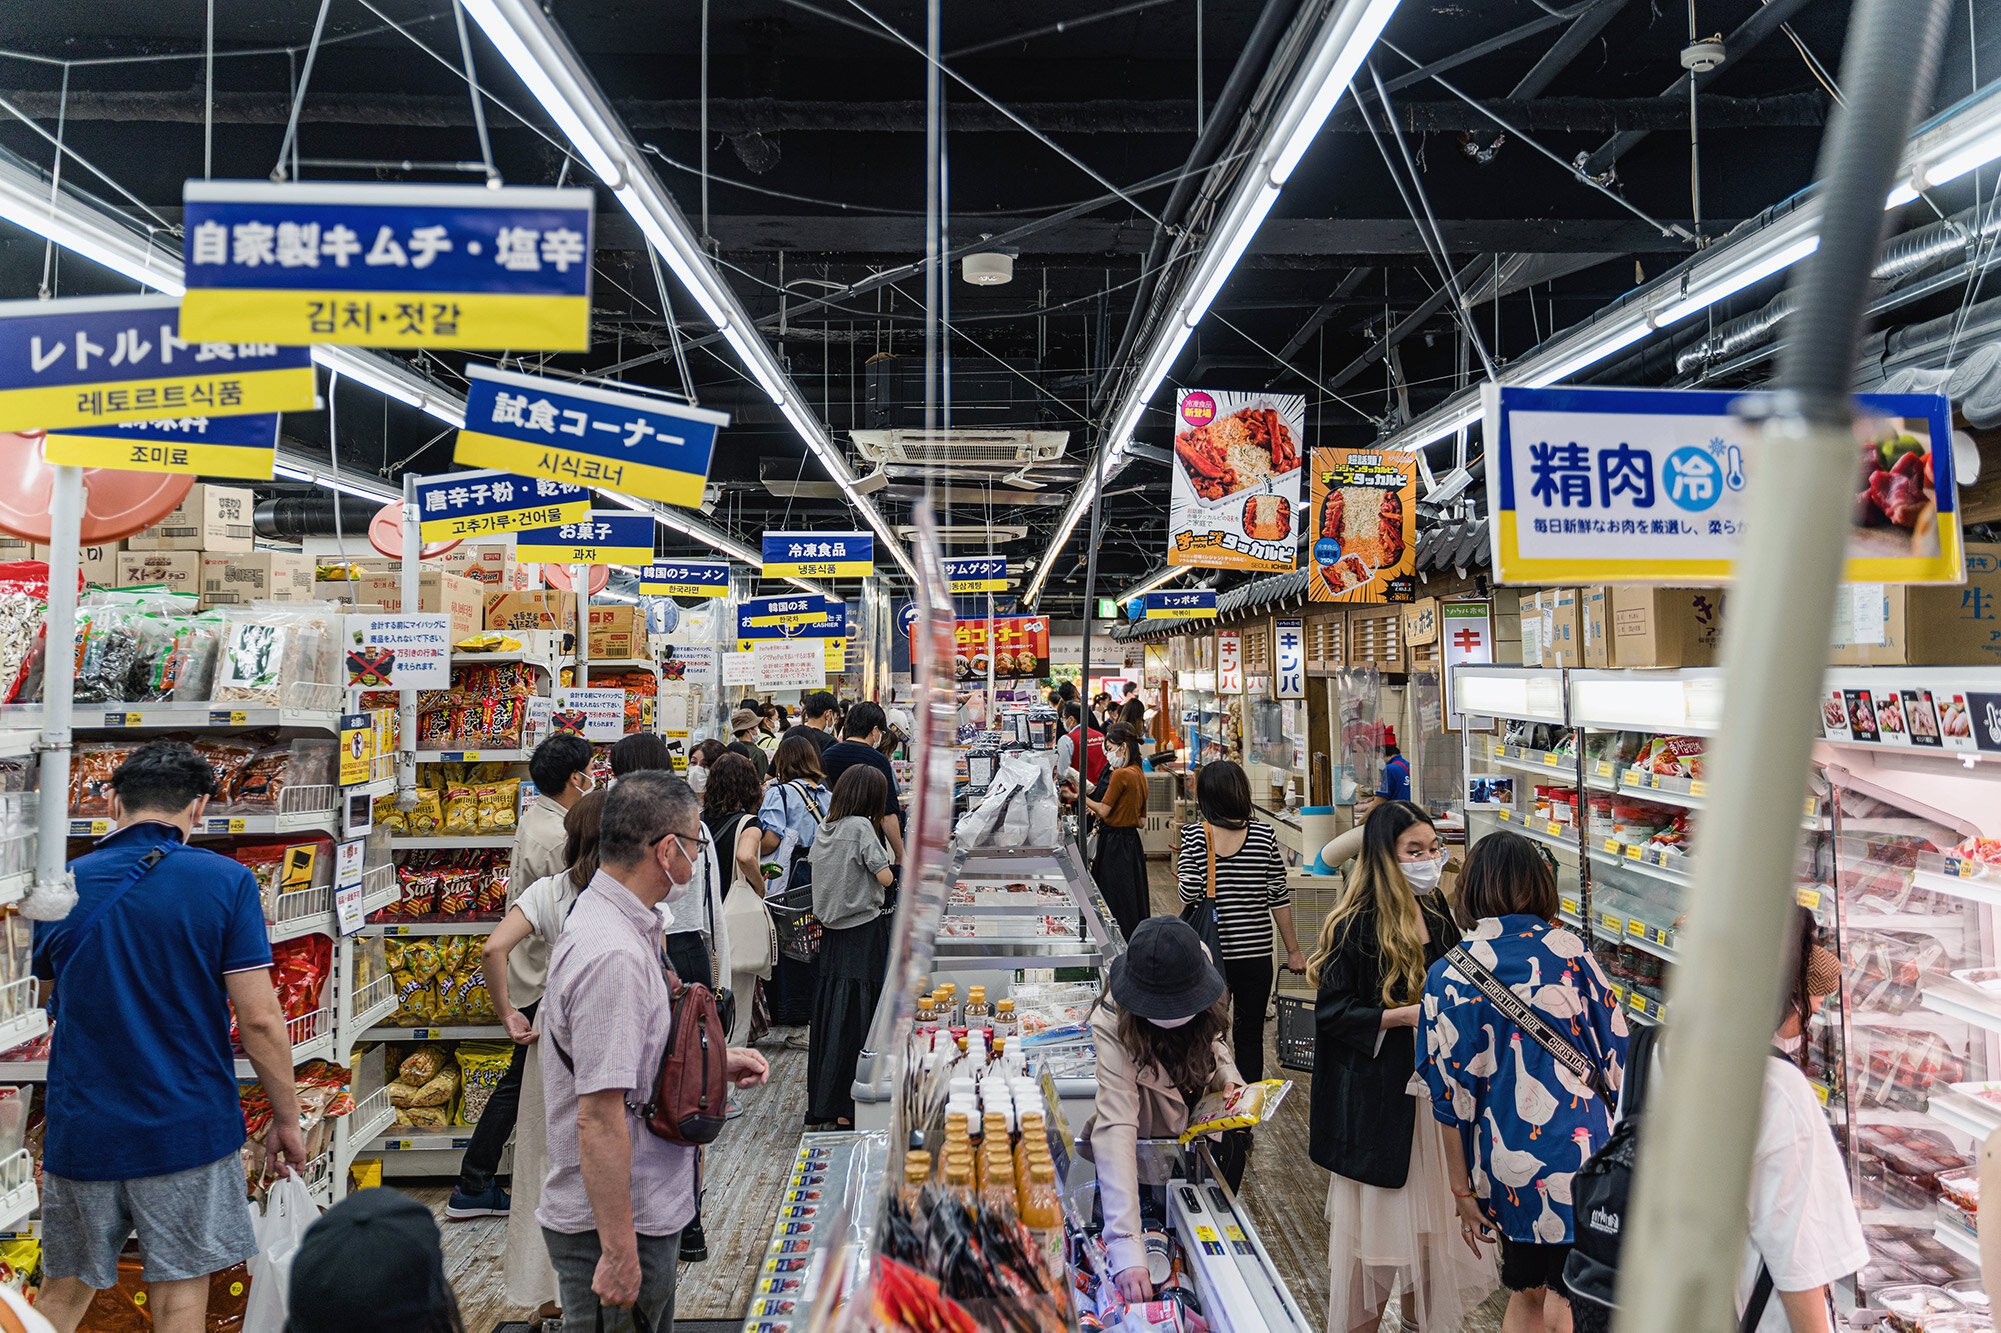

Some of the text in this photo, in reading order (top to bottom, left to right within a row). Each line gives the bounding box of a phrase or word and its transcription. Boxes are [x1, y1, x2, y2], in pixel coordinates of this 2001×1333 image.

[193, 220, 584, 273] 自家製キムチ・塩辛
[78, 381, 243, 416] 레토르트식품
[1185, 400, 1212, 409] 冷凍食品
[491, 392, 686, 449] 試食コーナー
[1184, 408, 1212, 419] 新登場
[130, 446, 189, 466] 조미료
[538, 452, 624, 487] 시식코너
[1529, 441, 1656, 509] 精肉
[1669, 454, 1714, 501] 冷
[1322, 472, 1408, 487] チーズタッカルビ
[558, 522, 613, 541] お菓子
[573, 548, 597, 562] 과자
[788, 543, 846, 558] 冷凍食品
[1175, 530, 1295, 564] チーズタッカルビ
[128, 566, 167, 581] ストーン
[643, 566, 725, 581] 韓国のラーメン
[798, 564, 837, 575] 냉동식품
[946, 562, 1003, 577] サムゲタン
[1271, 563, 1293, 571] ICHIBA
[668, 585, 700, 595] 한국라면
[948, 581, 982, 591] 동삼계탕
[768, 600, 808, 613] 韓国の茶
[1162, 595, 1199, 605] トッポギ
[954, 626, 1023, 644] 台コーナー
[1222, 641, 1238, 689] キンパ
[1280, 632, 1300, 693] キンパ
[402, 881, 436, 903] Sun
[442, 880, 472, 900] Sun
[1460, 958, 1478, 976] DIOR
[1482, 979, 1522, 1018] CHRISTIAN
[1520, 1013, 1541, 1033] DIOR
